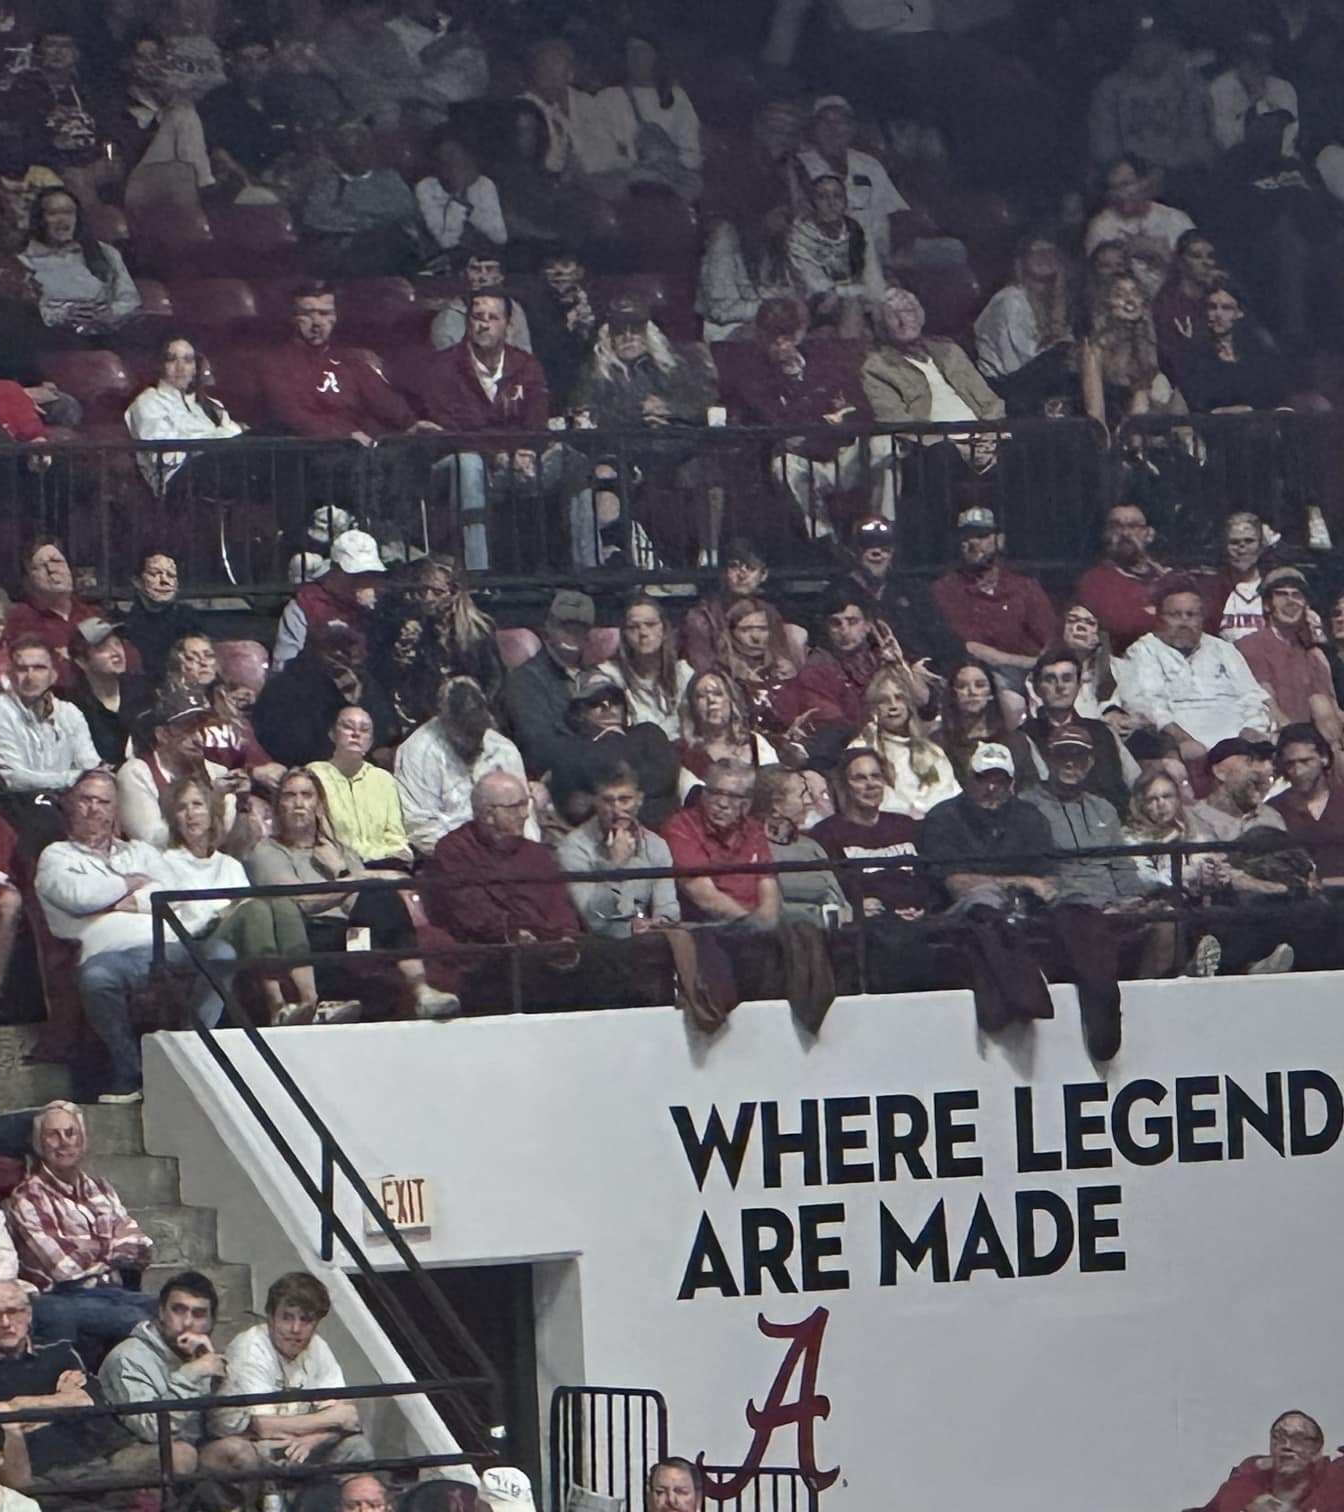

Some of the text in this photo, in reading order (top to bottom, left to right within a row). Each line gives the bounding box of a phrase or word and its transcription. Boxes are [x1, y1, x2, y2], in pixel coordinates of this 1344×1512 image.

[669, 1067, 1343, 1192] WHERE LEGEND
[380, 1177, 424, 1224] EXIT
[676, 1181, 1127, 1301] ARE MADE
